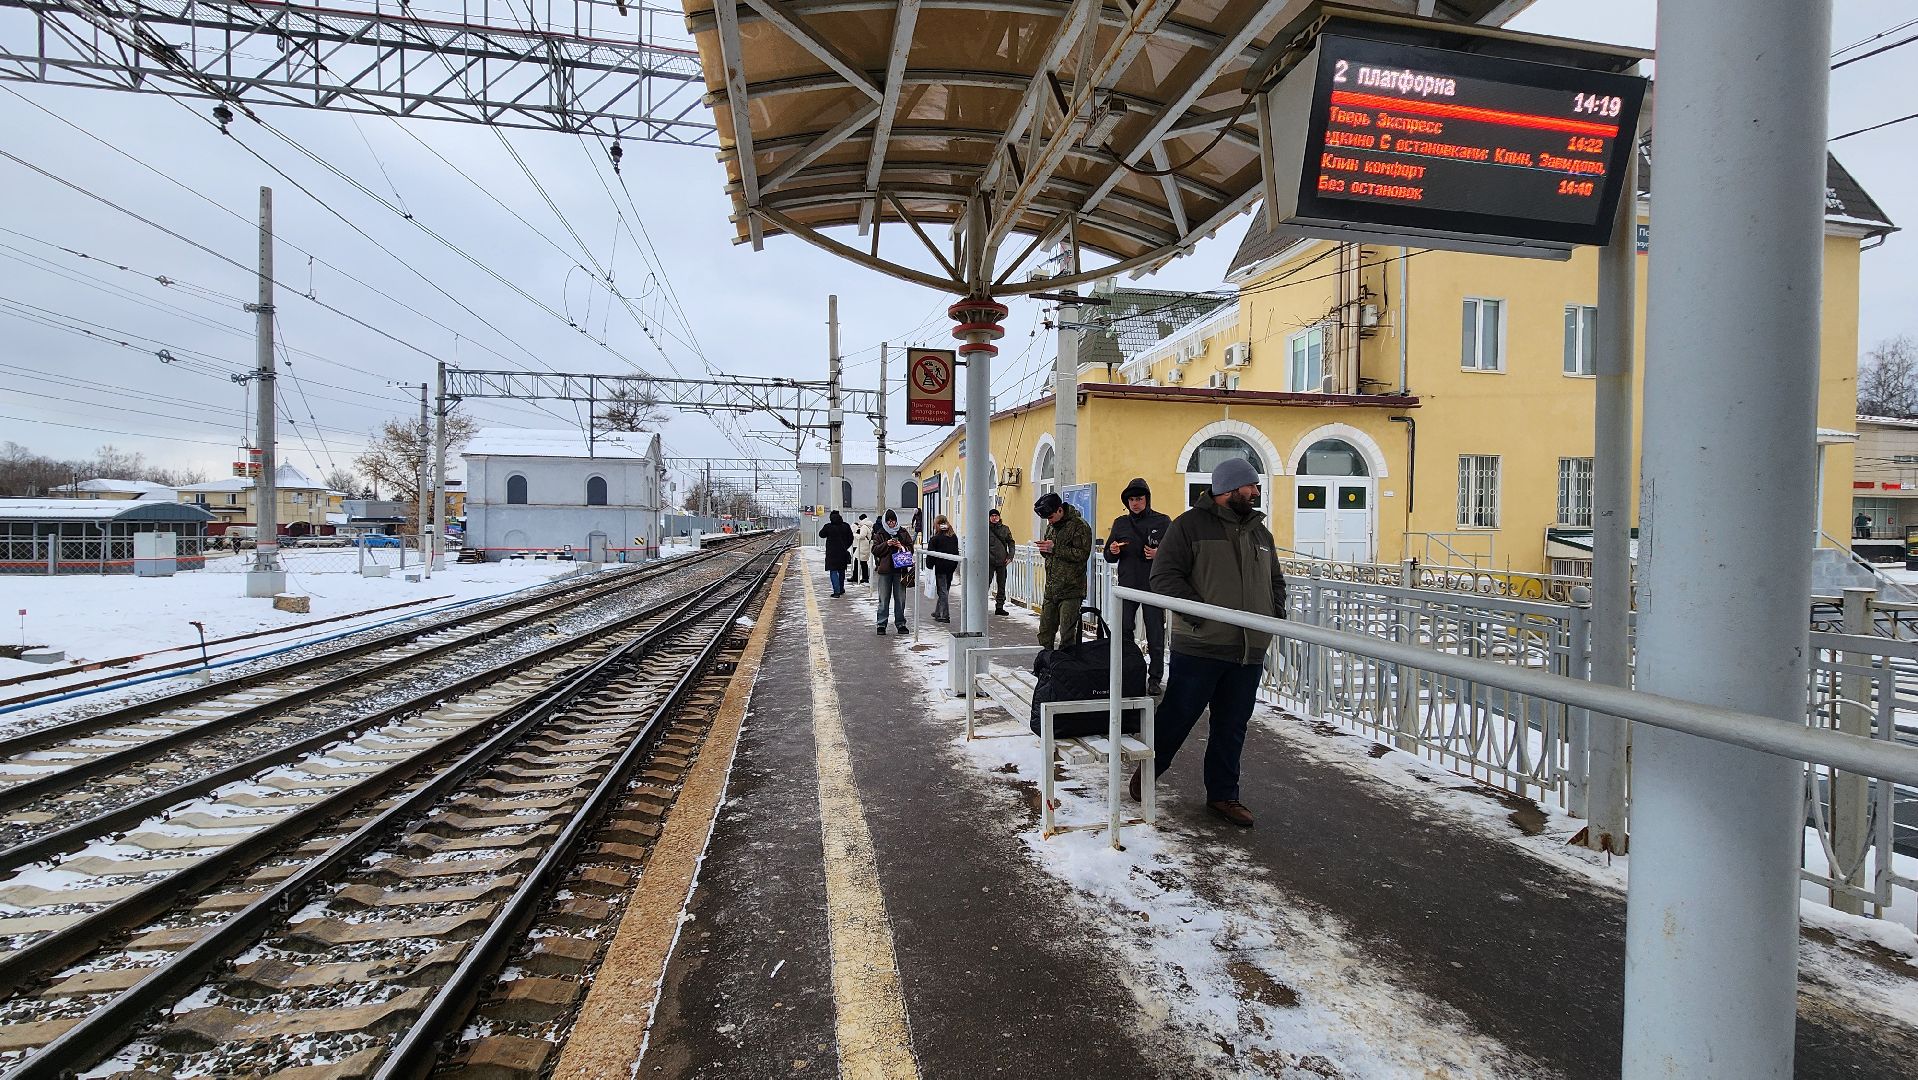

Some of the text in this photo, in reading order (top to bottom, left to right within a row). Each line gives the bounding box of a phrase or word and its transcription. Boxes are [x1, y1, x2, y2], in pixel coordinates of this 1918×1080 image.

[1334, 60, 1457, 97] 2 платформа
[1574, 92, 1622, 117] 14:19
[1330, 106, 1444, 135] Тверь Экспресс
[1380, 134, 1392, 149] С
[1494, 147, 1533, 167] Клин,
[1538, 152, 1606, 175] Завидово,
[1567, 136, 1604, 153] 14:22
[1321, 153, 1426, 180] Клин комфорт
[1318, 175, 1424, 200] Без остановок
[1558, 179, 1594, 197] 14:40
